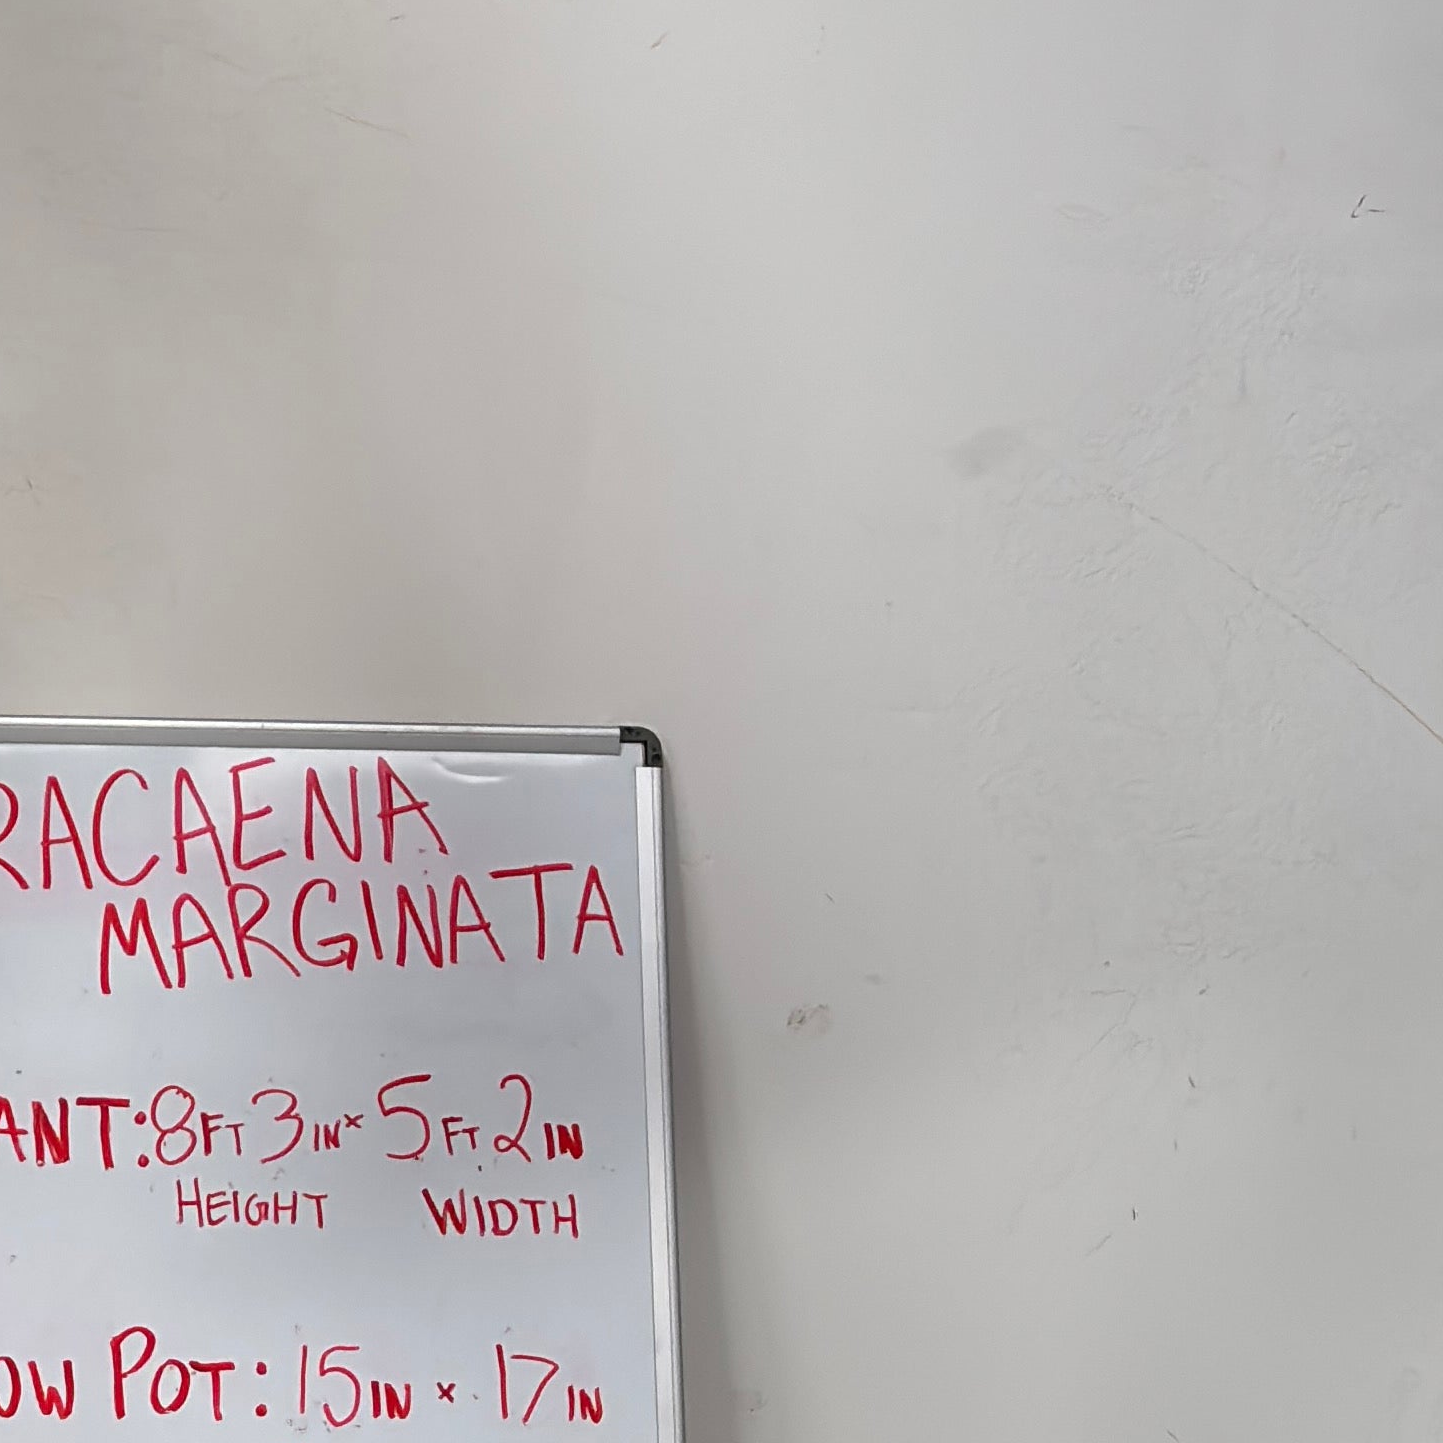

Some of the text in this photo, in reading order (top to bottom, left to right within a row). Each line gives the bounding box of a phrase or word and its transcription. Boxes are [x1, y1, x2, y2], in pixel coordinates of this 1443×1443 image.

[97, 864, 623, 996] MARGINATA
[176, 1179, 578, 1239] HEIGHT WIDTH
[109, 1326, 267, 1420] POT:
